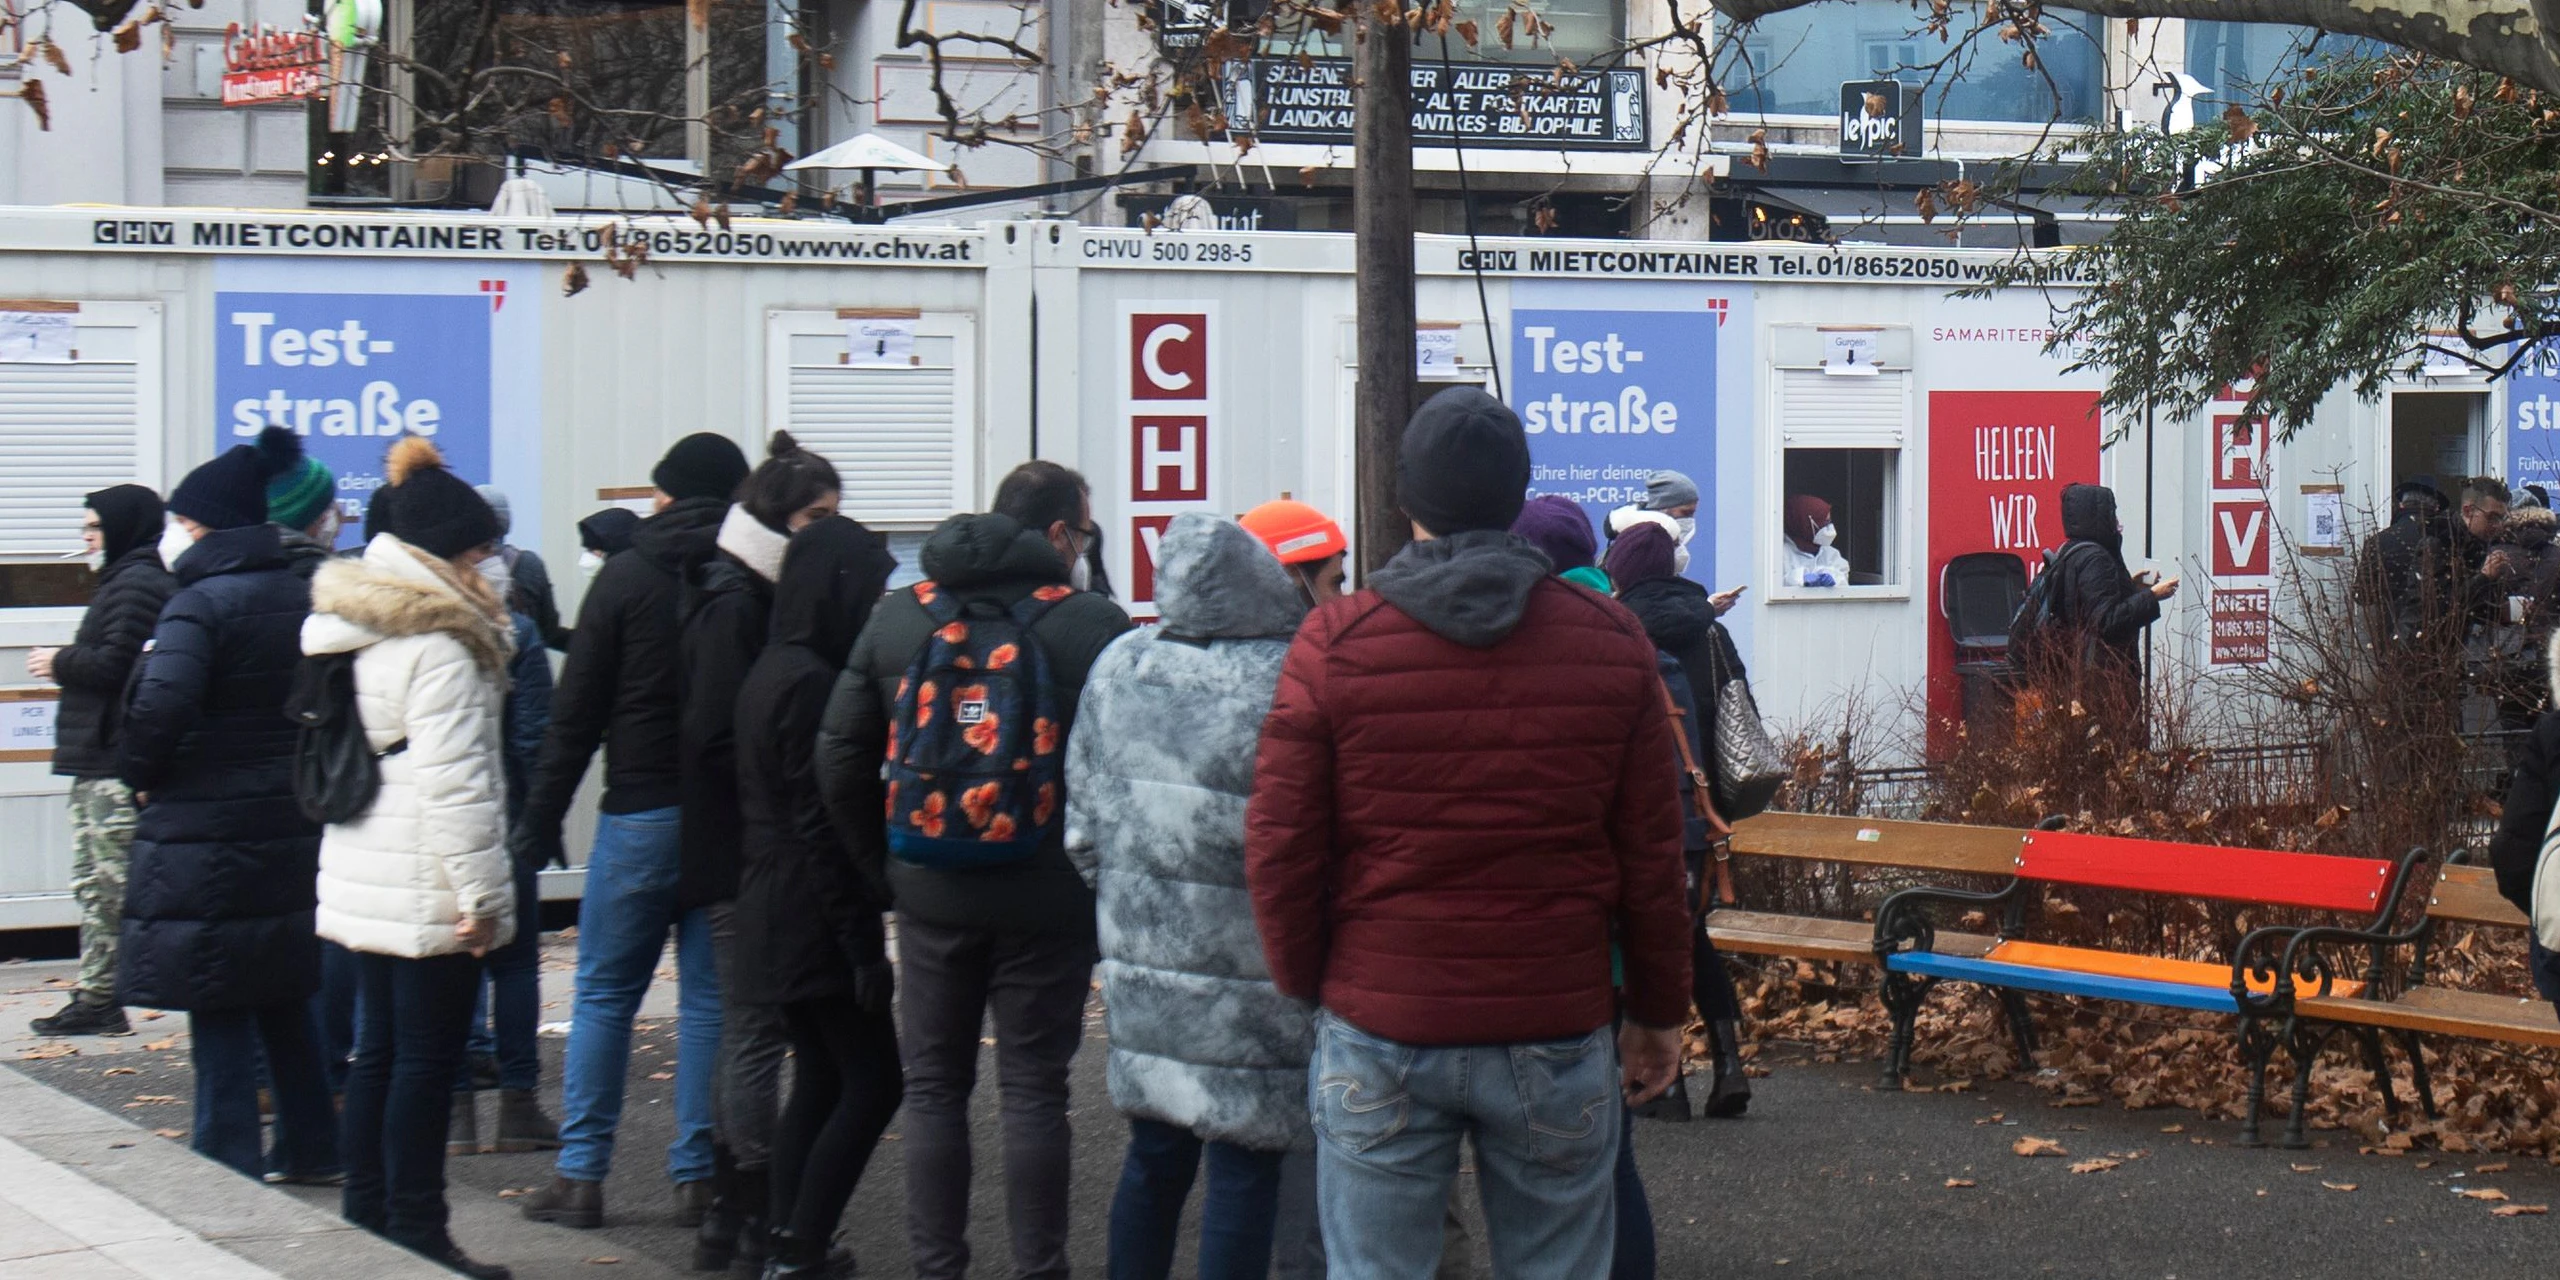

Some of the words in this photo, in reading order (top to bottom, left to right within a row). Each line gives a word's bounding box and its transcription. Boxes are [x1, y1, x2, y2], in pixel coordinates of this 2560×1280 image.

[1453, 72, 1511, 91] ALLER
[1267, 86, 1355, 107] KUNSTBL
[1269, 108, 1356, 128] LANDKA
[94, 220, 174, 245] CHV
[193, 222, 502, 250] MIETCONTAINER
[517, 228, 577, 251] Tel.
[777, 237, 971, 261] www.chv.at
[1083, 239, 1142, 258] CHVU
[1152, 242, 1189, 261] 500
[1195, 243, 1252, 262] 298-5
[1458, 249, 1516, 271] CHV
[1530, 251, 1758, 275] MIETCONTAINER
[1768, 255, 1812, 275] Tel.
[1817, 255, 1959, 278] 01/8652050
[231, 312, 395, 367] Test-
[1932, 327, 2098, 343] SAMARITERBND
[1422, 348, 1433, 365] 2
[1524, 326, 1644, 374] Test-
[2050, 346, 2085, 360] WIE
[232, 380, 441, 437] straße
[1524, 385, 1678, 434] straße
[1974, 424, 2056, 482] HELFEN
[1569, 463, 1599, 480] hier
[2518, 456, 2551, 472] Führe
[337, 472, 383, 490] dein
[1989, 493, 2040, 550] WIR
[2214, 593, 2267, 612] MIETE
